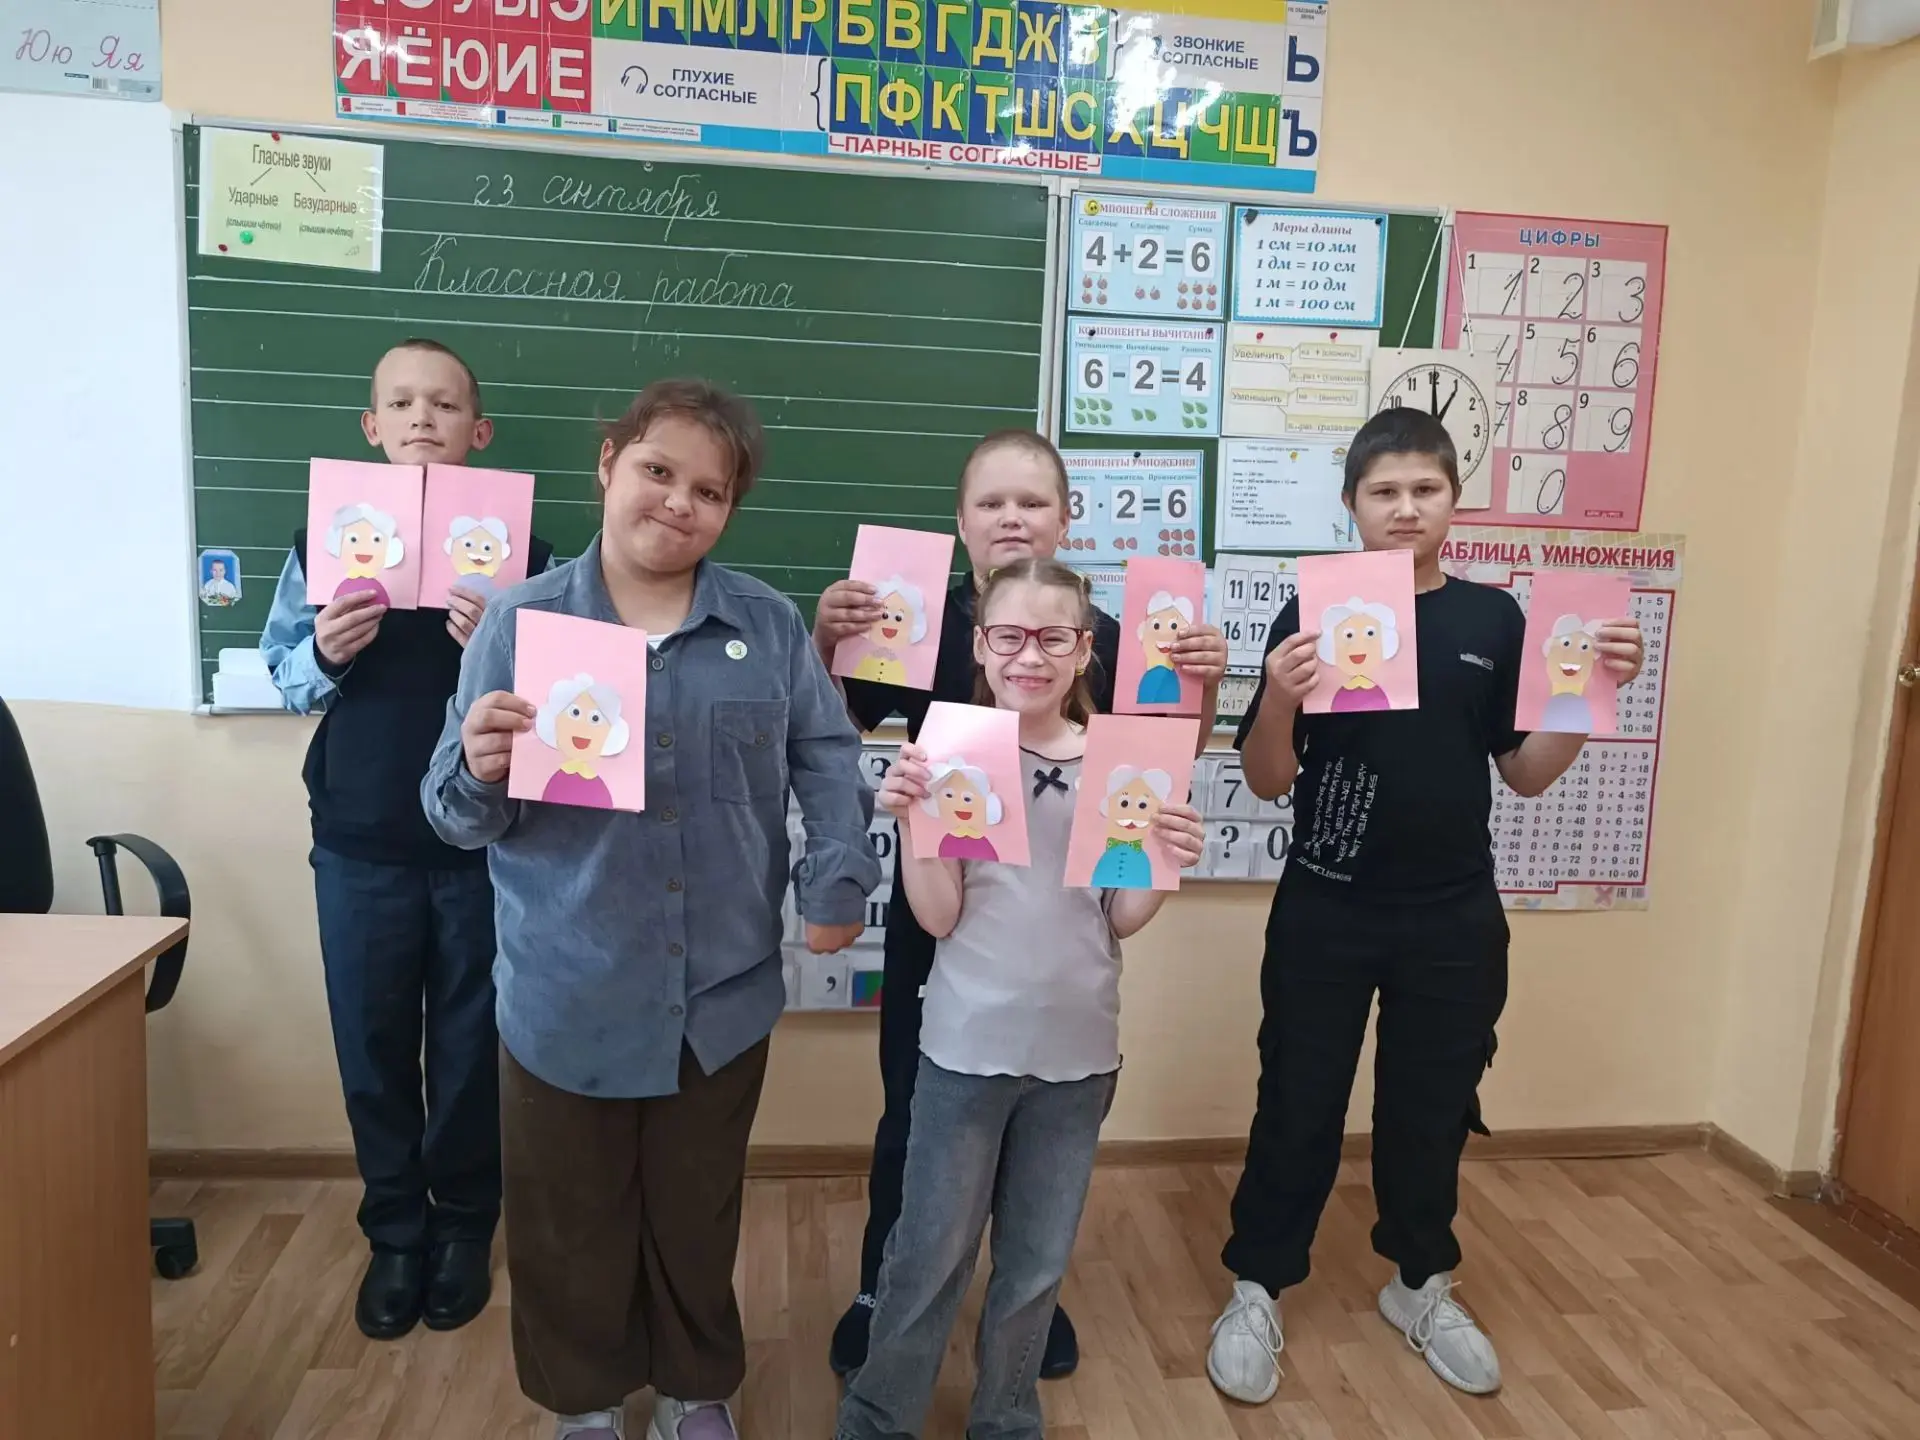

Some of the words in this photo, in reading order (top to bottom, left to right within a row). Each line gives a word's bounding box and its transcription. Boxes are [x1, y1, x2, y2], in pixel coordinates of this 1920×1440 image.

[1173, 35, 1245, 53] ЗВОНКИЕ
[1162, 51, 1259, 71] СОГЛАСНЫЕ
[672, 68, 735, 86] ГЛУХИЕ
[653, 83, 758, 105] СОГЛАСНЫЕ
[252, 144, 300, 169] Гласные
[302, 154, 332, 175] звуки
[845, 136, 942, 160] ПАРНЫЕ
[949, 144, 1089, 171] СОГЛАСНЫЕ
[228, 186, 279, 207] Ударные
[474, 174, 515, 208] 23
[294, 192, 357, 215] Безударные
[1161, 208, 1217, 220] СЛОЖЕНИЯ
[1272, 222, 1308, 235] Меры
[1311, 223, 1352, 235] длины
[1268, 240, 1291, 251] см
[1328, 243, 1356, 253] мм
[1519, 229, 1600, 248] ЦИФРЫ
[1086, 236, 1106, 266] 4
[1138, 239, 1158, 269] 2
[1191, 242, 1210, 272] 6
[1268, 255, 1291, 270] дм
[1311, 260, 1330, 272] 10
[1334, 262, 1356, 272] см
[414, 234, 626, 303] Классная
[644, 252, 797, 324] работа
[1266, 279, 1281, 289] м
[1300, 279, 1319, 290] 10
[1323, 277, 1346, 291] дм
[1468, 253, 1476, 269] 1
[1530, 257, 1540, 274] 2
[1558, 272, 1584, 319] 2
[1591, 261, 1600, 277] 3
[1619, 276, 1646, 323] 3
[1266, 298, 1280, 308] м
[1300, 299, 1330, 310] 100
[1333, 300, 1355, 311] см
[1234, 350, 1285, 361] Увеличить
[1525, 324, 1535, 339] 5
[1552, 338, 1580, 385] 5
[1587, 327, 1596, 342] 6
[1612, 342, 1640, 388] 6
[1084, 358, 1103, 388] 6
[1135, 360, 1154, 389] 2
[1186, 362, 1206, 391] 4
[1407, 377, 1417, 392] 11
[1232, 392, 1283, 404] Уменьшить
[1469, 397, 1476, 411] 2
[1517, 390, 1527, 406] 8
[1543, 404, 1572, 450] 8
[1579, 393, 1589, 408] 9
[1603, 407, 1633, 452] 9
[1473, 424, 1480, 438] 3
[1131, 457, 1196, 467] УМНОЖЕНИЯ
[1464, 450, 1471, 462] 4
[1069, 490, 1085, 520] 3
[1116, 489, 1136, 519] 2
[1168, 489, 1187, 518] 6
[1440, 541, 1532, 565] АБЛИЦА
[1541, 544, 1675, 569] УМНОЖЕНИЯ
[1229, 580, 1244, 599] 11
[1253, 582, 1270, 601] 12
[1278, 583, 1296, 602] 13
[1656, 597, 1663, 605] 5
[1654, 611, 1664, 620] 10
[1224, 621, 1241, 641] 16
[1250, 623, 1266, 642] 17
[1602, 751, 1608, 759] 9
[1639, 765, 1649, 773] 18
[1619, 778, 1625, 786] 3
[1598, 791, 1604, 799] 9
[1618, 791, 1625, 799] 4
[1595, 817, 1601, 825] 9
[1616, 817, 1622, 825] 6
[1633, 818, 1644, 826] 54
[1220, 825, 1240, 859] ?
[1594, 830, 1600, 838] 9
